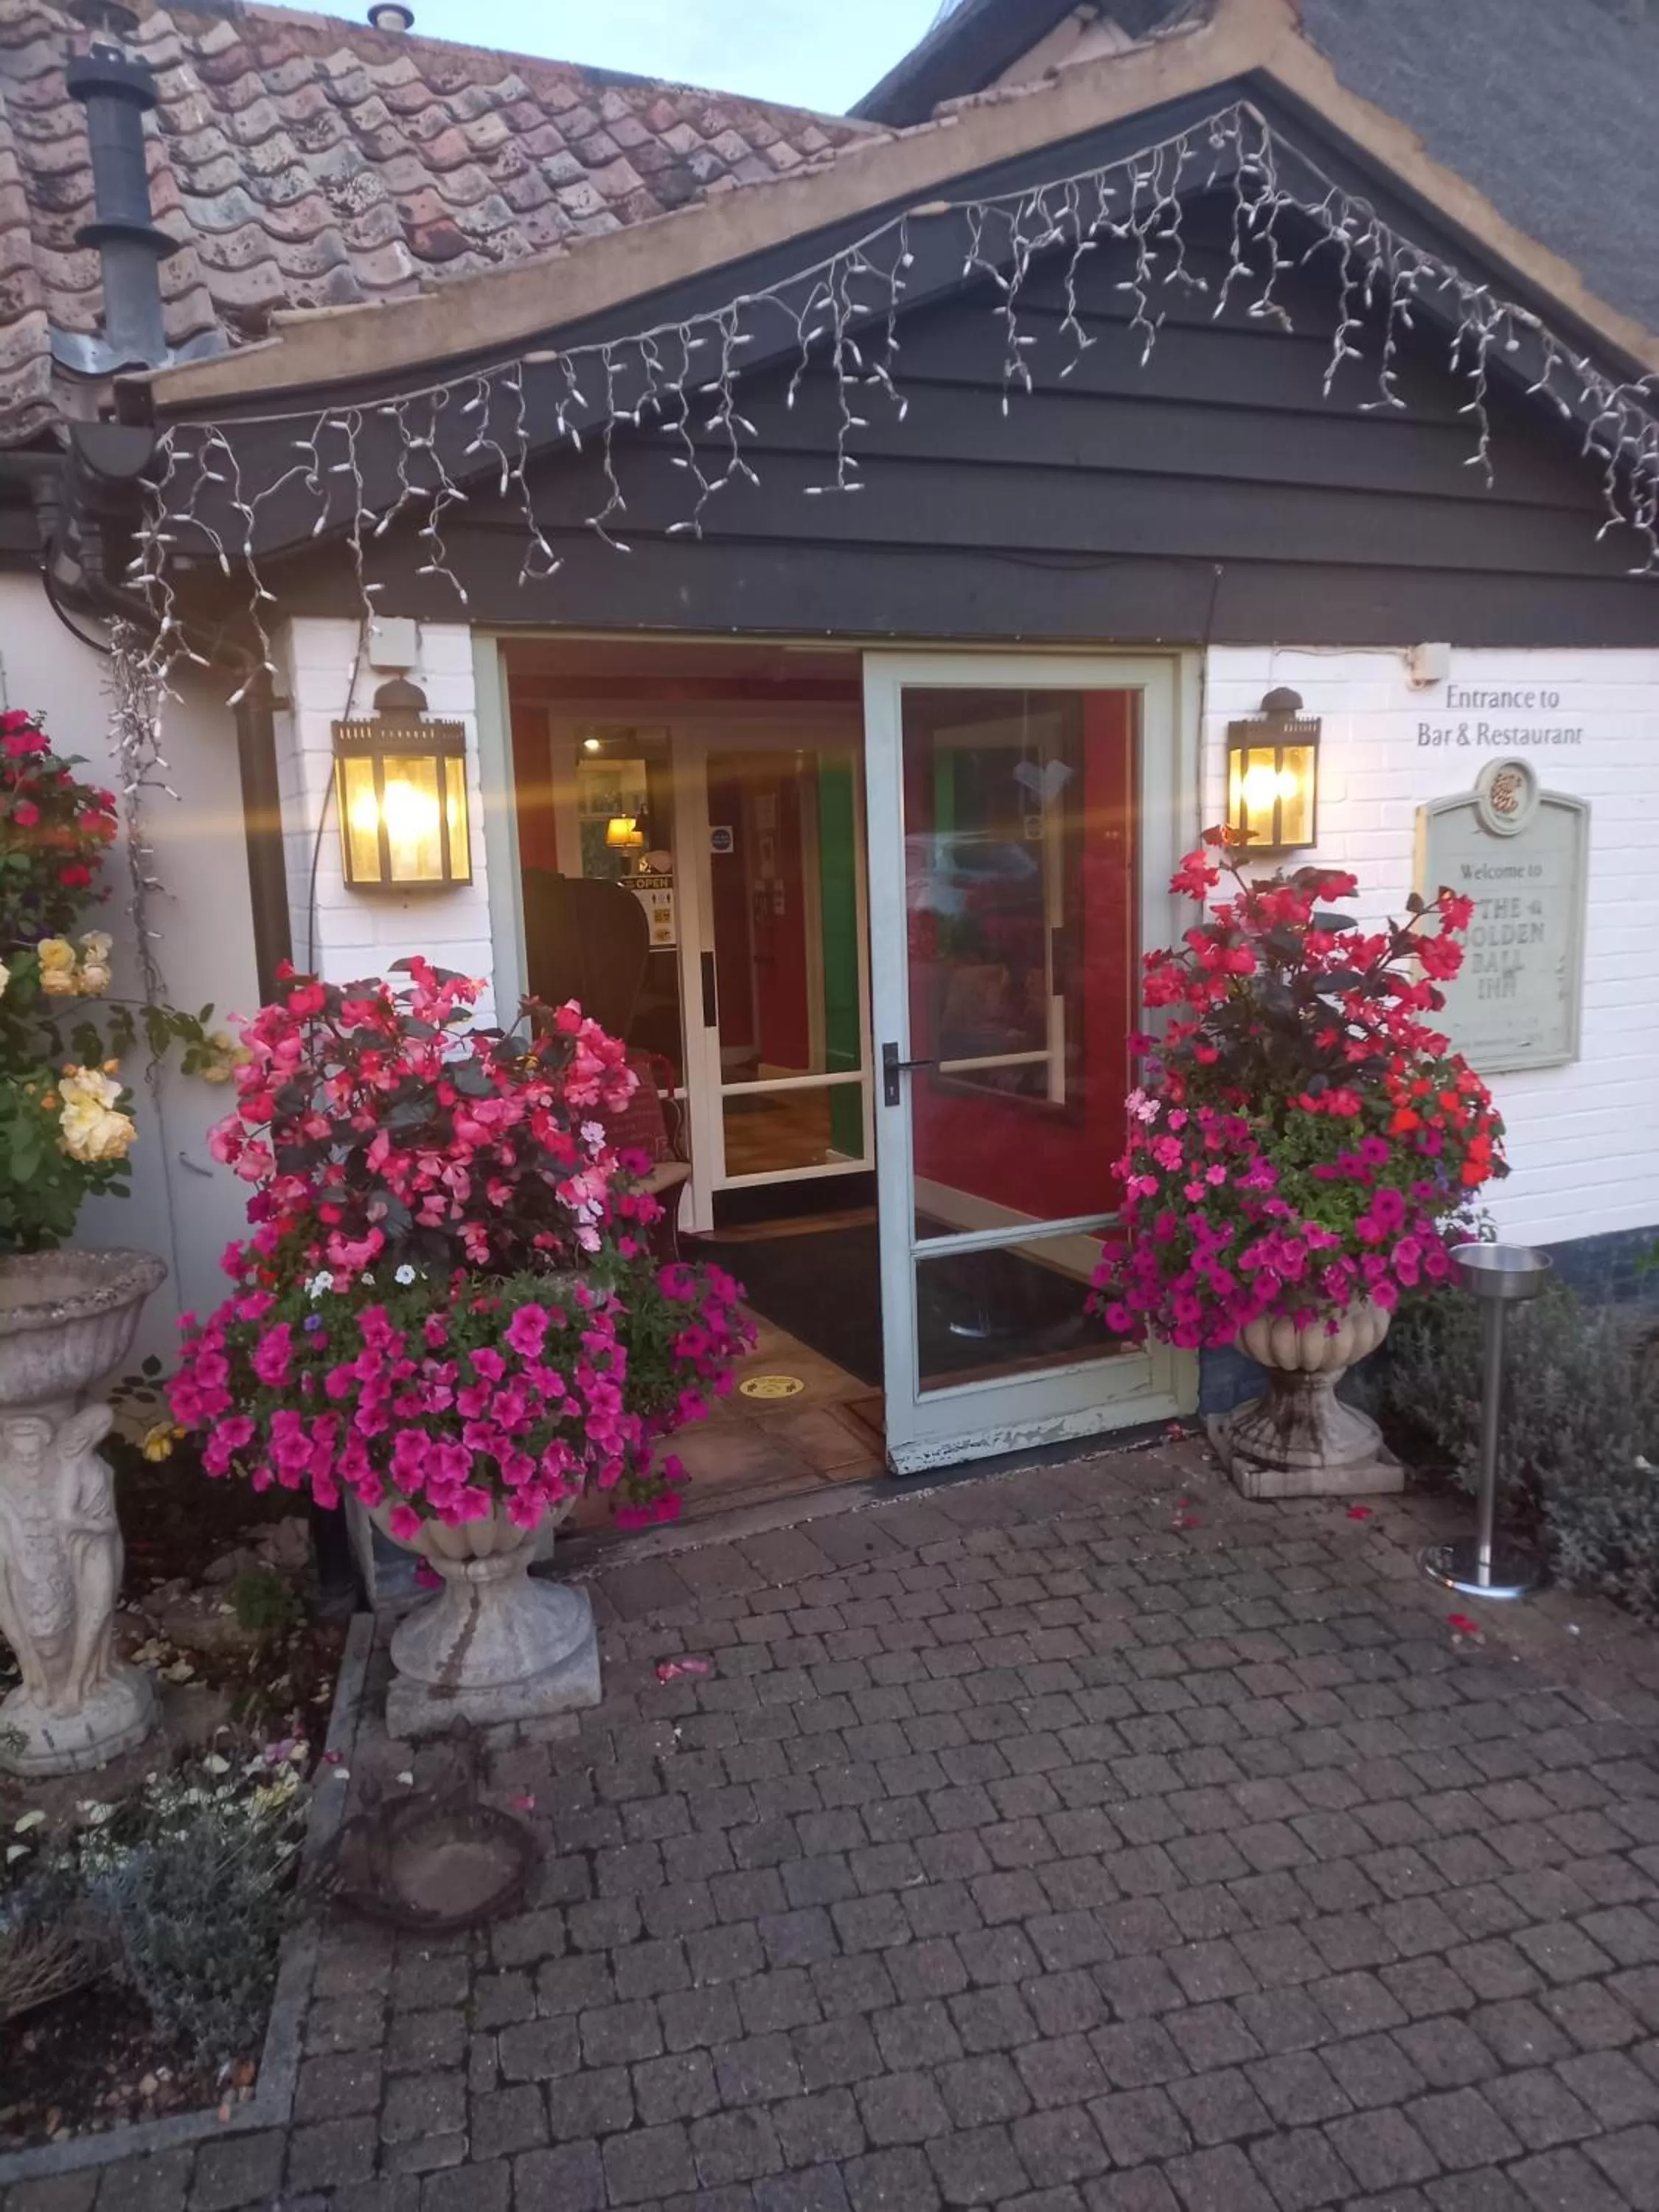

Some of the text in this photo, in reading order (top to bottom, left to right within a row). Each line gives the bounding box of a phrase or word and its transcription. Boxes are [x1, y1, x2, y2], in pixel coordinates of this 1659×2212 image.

[1446, 684, 1559, 709] Entrance to
[1417, 722, 1583, 747] Bar & Restaurant
[1461, 863, 1526, 880] Welcome
[636, 878, 669, 889] OPEN
[1478, 897, 1521, 919] THE
